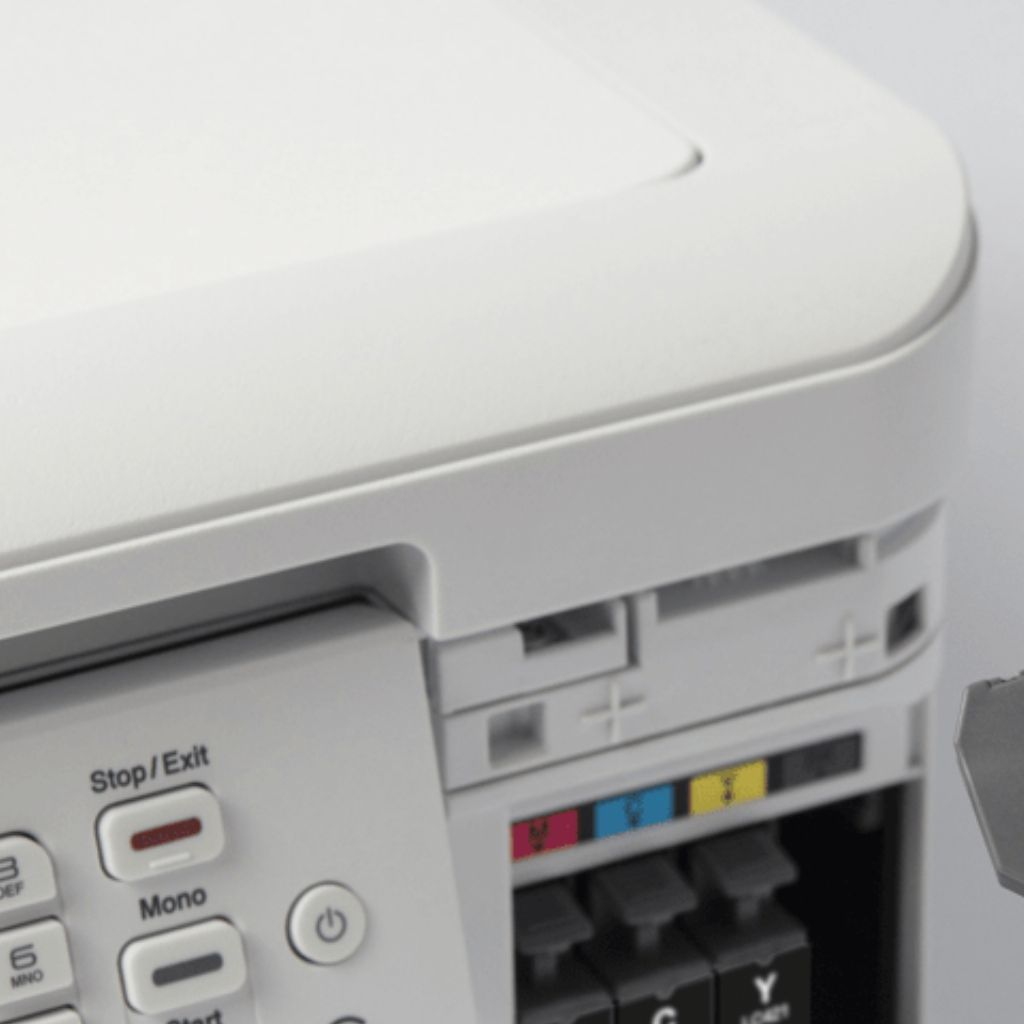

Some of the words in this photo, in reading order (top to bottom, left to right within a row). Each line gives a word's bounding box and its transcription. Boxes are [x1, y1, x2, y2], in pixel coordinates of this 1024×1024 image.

[139, 888, 207, 921] Mono
[10, 943, 37, 970] 6
[10, 968, 44, 989] MNO
[754, 970, 778, 1005] Y
